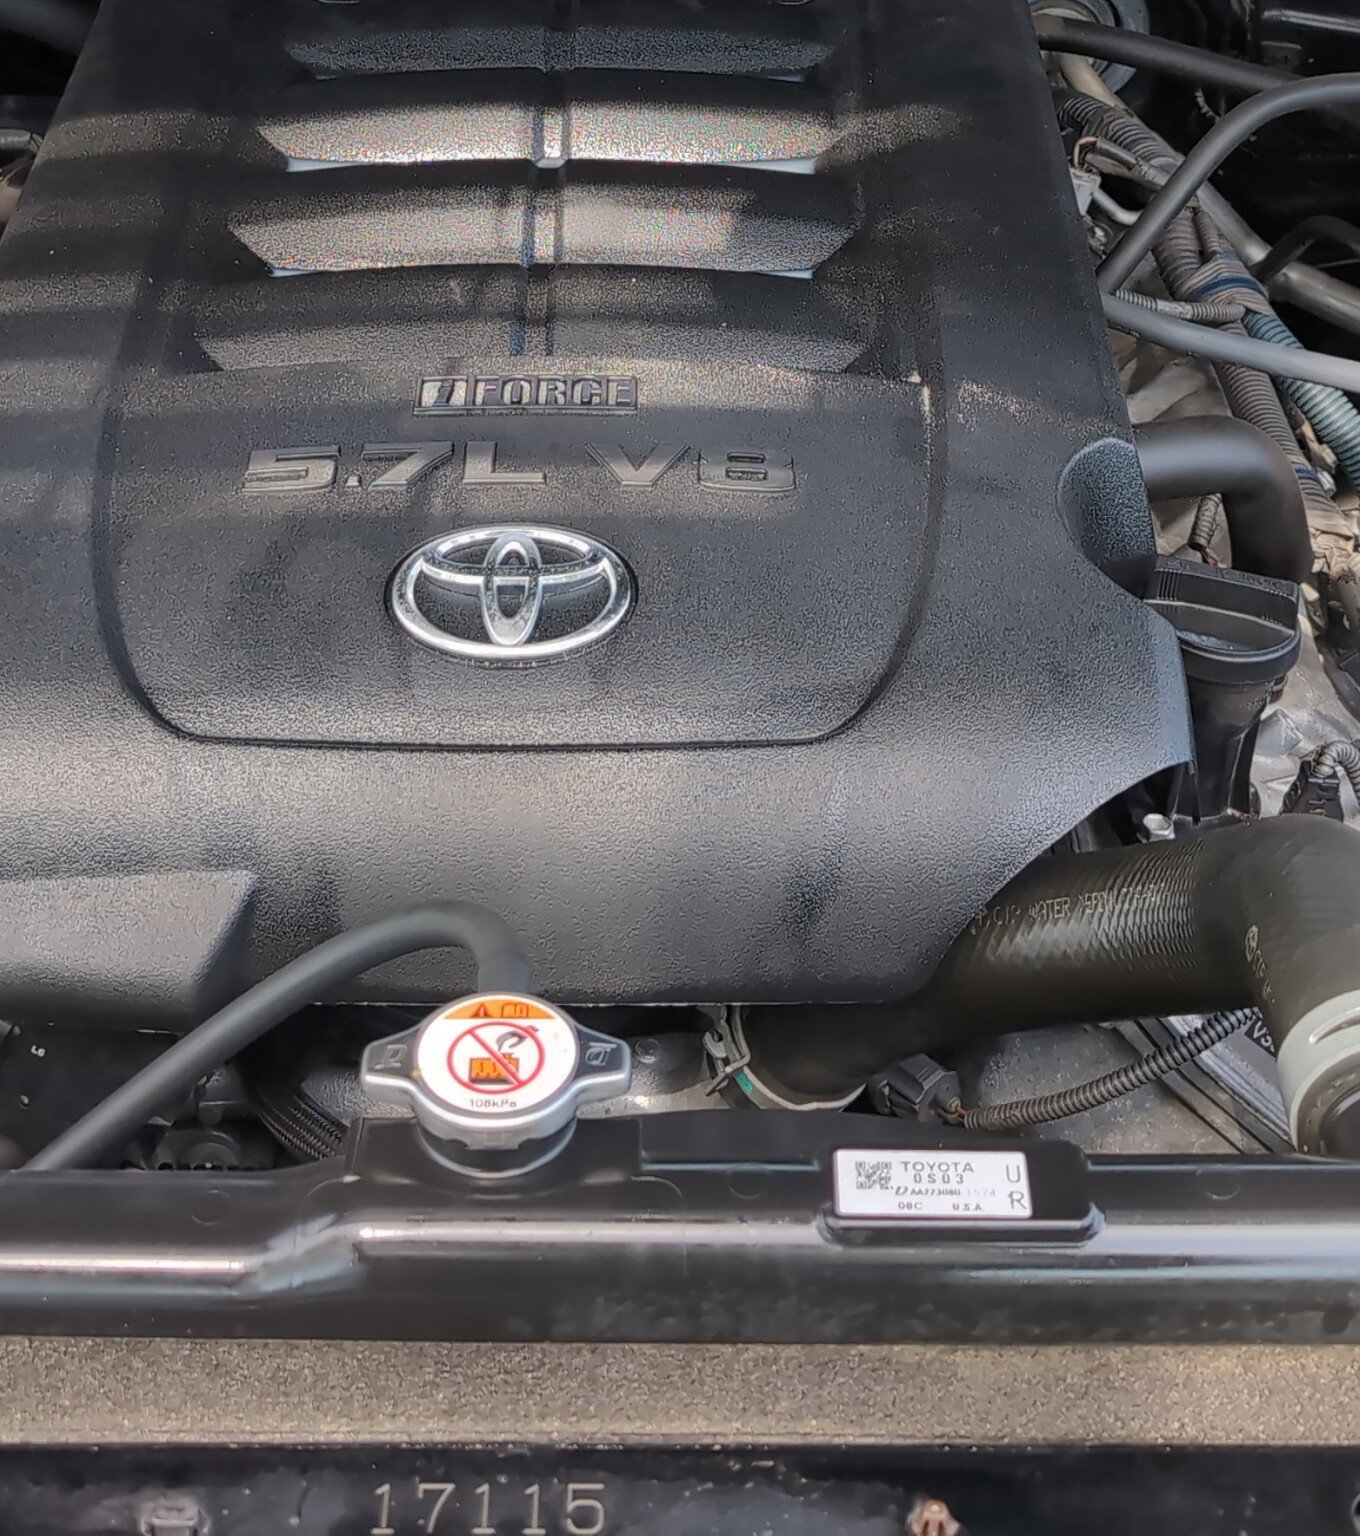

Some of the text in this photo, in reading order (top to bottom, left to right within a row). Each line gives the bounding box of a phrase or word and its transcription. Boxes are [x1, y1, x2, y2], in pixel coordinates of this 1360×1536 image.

[242, 442, 798, 492] 5.7L V8
[470, 1098, 517, 1108] 108kPa
[902, 1161, 974, 1173] TOYOTA
[371, 1482, 606, 1535] 17115
